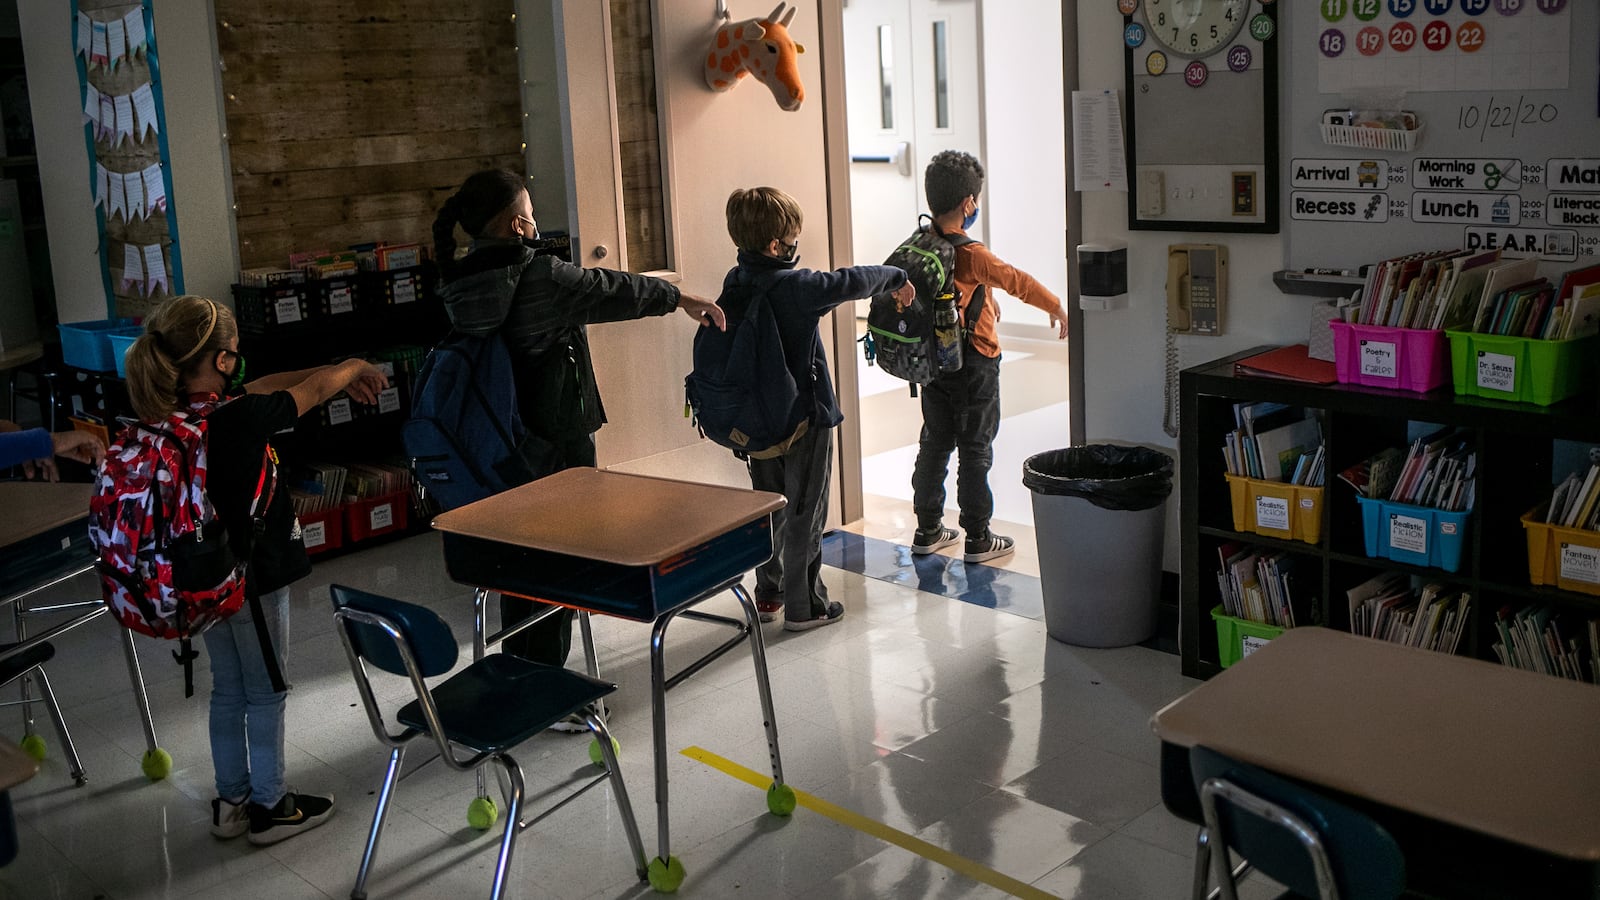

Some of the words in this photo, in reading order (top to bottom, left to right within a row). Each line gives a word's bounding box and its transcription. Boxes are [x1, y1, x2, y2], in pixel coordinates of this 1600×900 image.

[1225, 7, 1233, 22] 4
[1327, 0, 1341, 17] 11
[1358, 0, 1376, 15] 12
[1158, 12, 1165, 26] 8
[1172, 27, 1179, 41] 7
[1210, 25, 1218, 39] 5
[1190, 33, 1198, 47] 6
[1322, 34, 1341, 52] 18
[1361, 33, 1380, 50] 19
[1391, 28, 1413, 45] 20
[1427, 28, 1447, 44] 21
[1459, 29, 1482, 46] 22
[1458, 96, 1559, 142] 10/22/20
[1296, 166, 1349, 181] Arrival
[1419, 160, 1475, 175] Morning
[1429, 176, 1464, 187] Work
[1296, 197, 1356, 216] Recess
[1421, 199, 1478, 218] Lunch
[1563, 212, 1599, 224] Block
[1467, 232, 1542, 252] D.EA.R.
[1365, 347, 1391, 358] Poetry
[1479, 361, 1489, 369] Dr.
[1491, 363, 1512, 373] Seuss
[1393, 519, 1423, 531] Realistic
[1565, 549, 1597, 562] Fantasy
